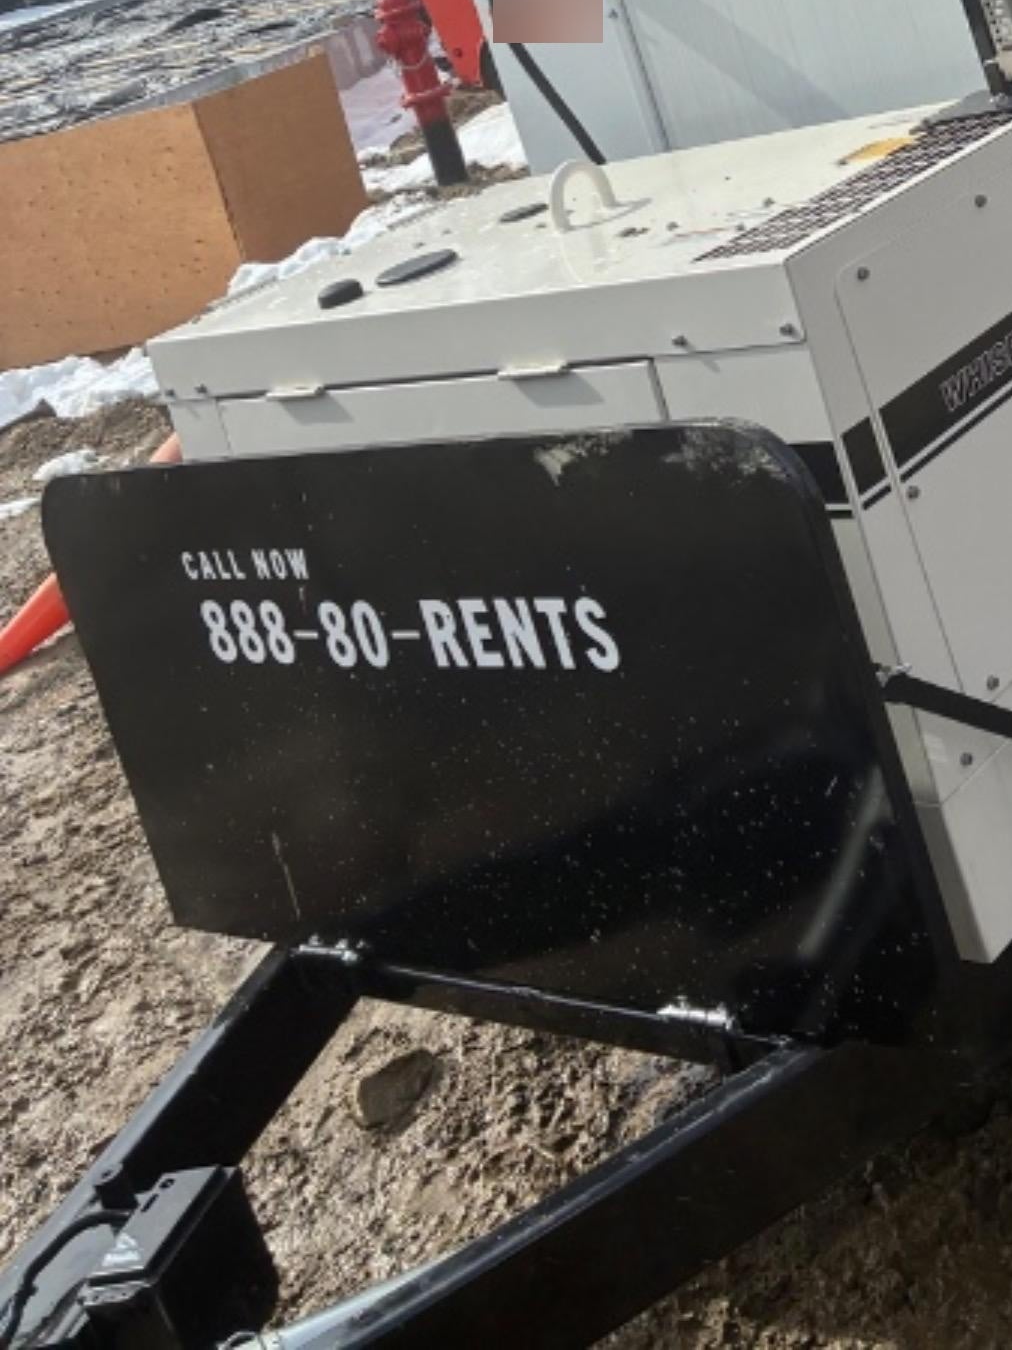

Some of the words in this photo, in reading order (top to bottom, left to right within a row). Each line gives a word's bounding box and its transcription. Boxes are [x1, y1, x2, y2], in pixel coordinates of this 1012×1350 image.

[180, 550, 247, 581] CALL
[250, 548, 310, 581] NOW
[200, 596, 621, 672] 888-80-RENTS
